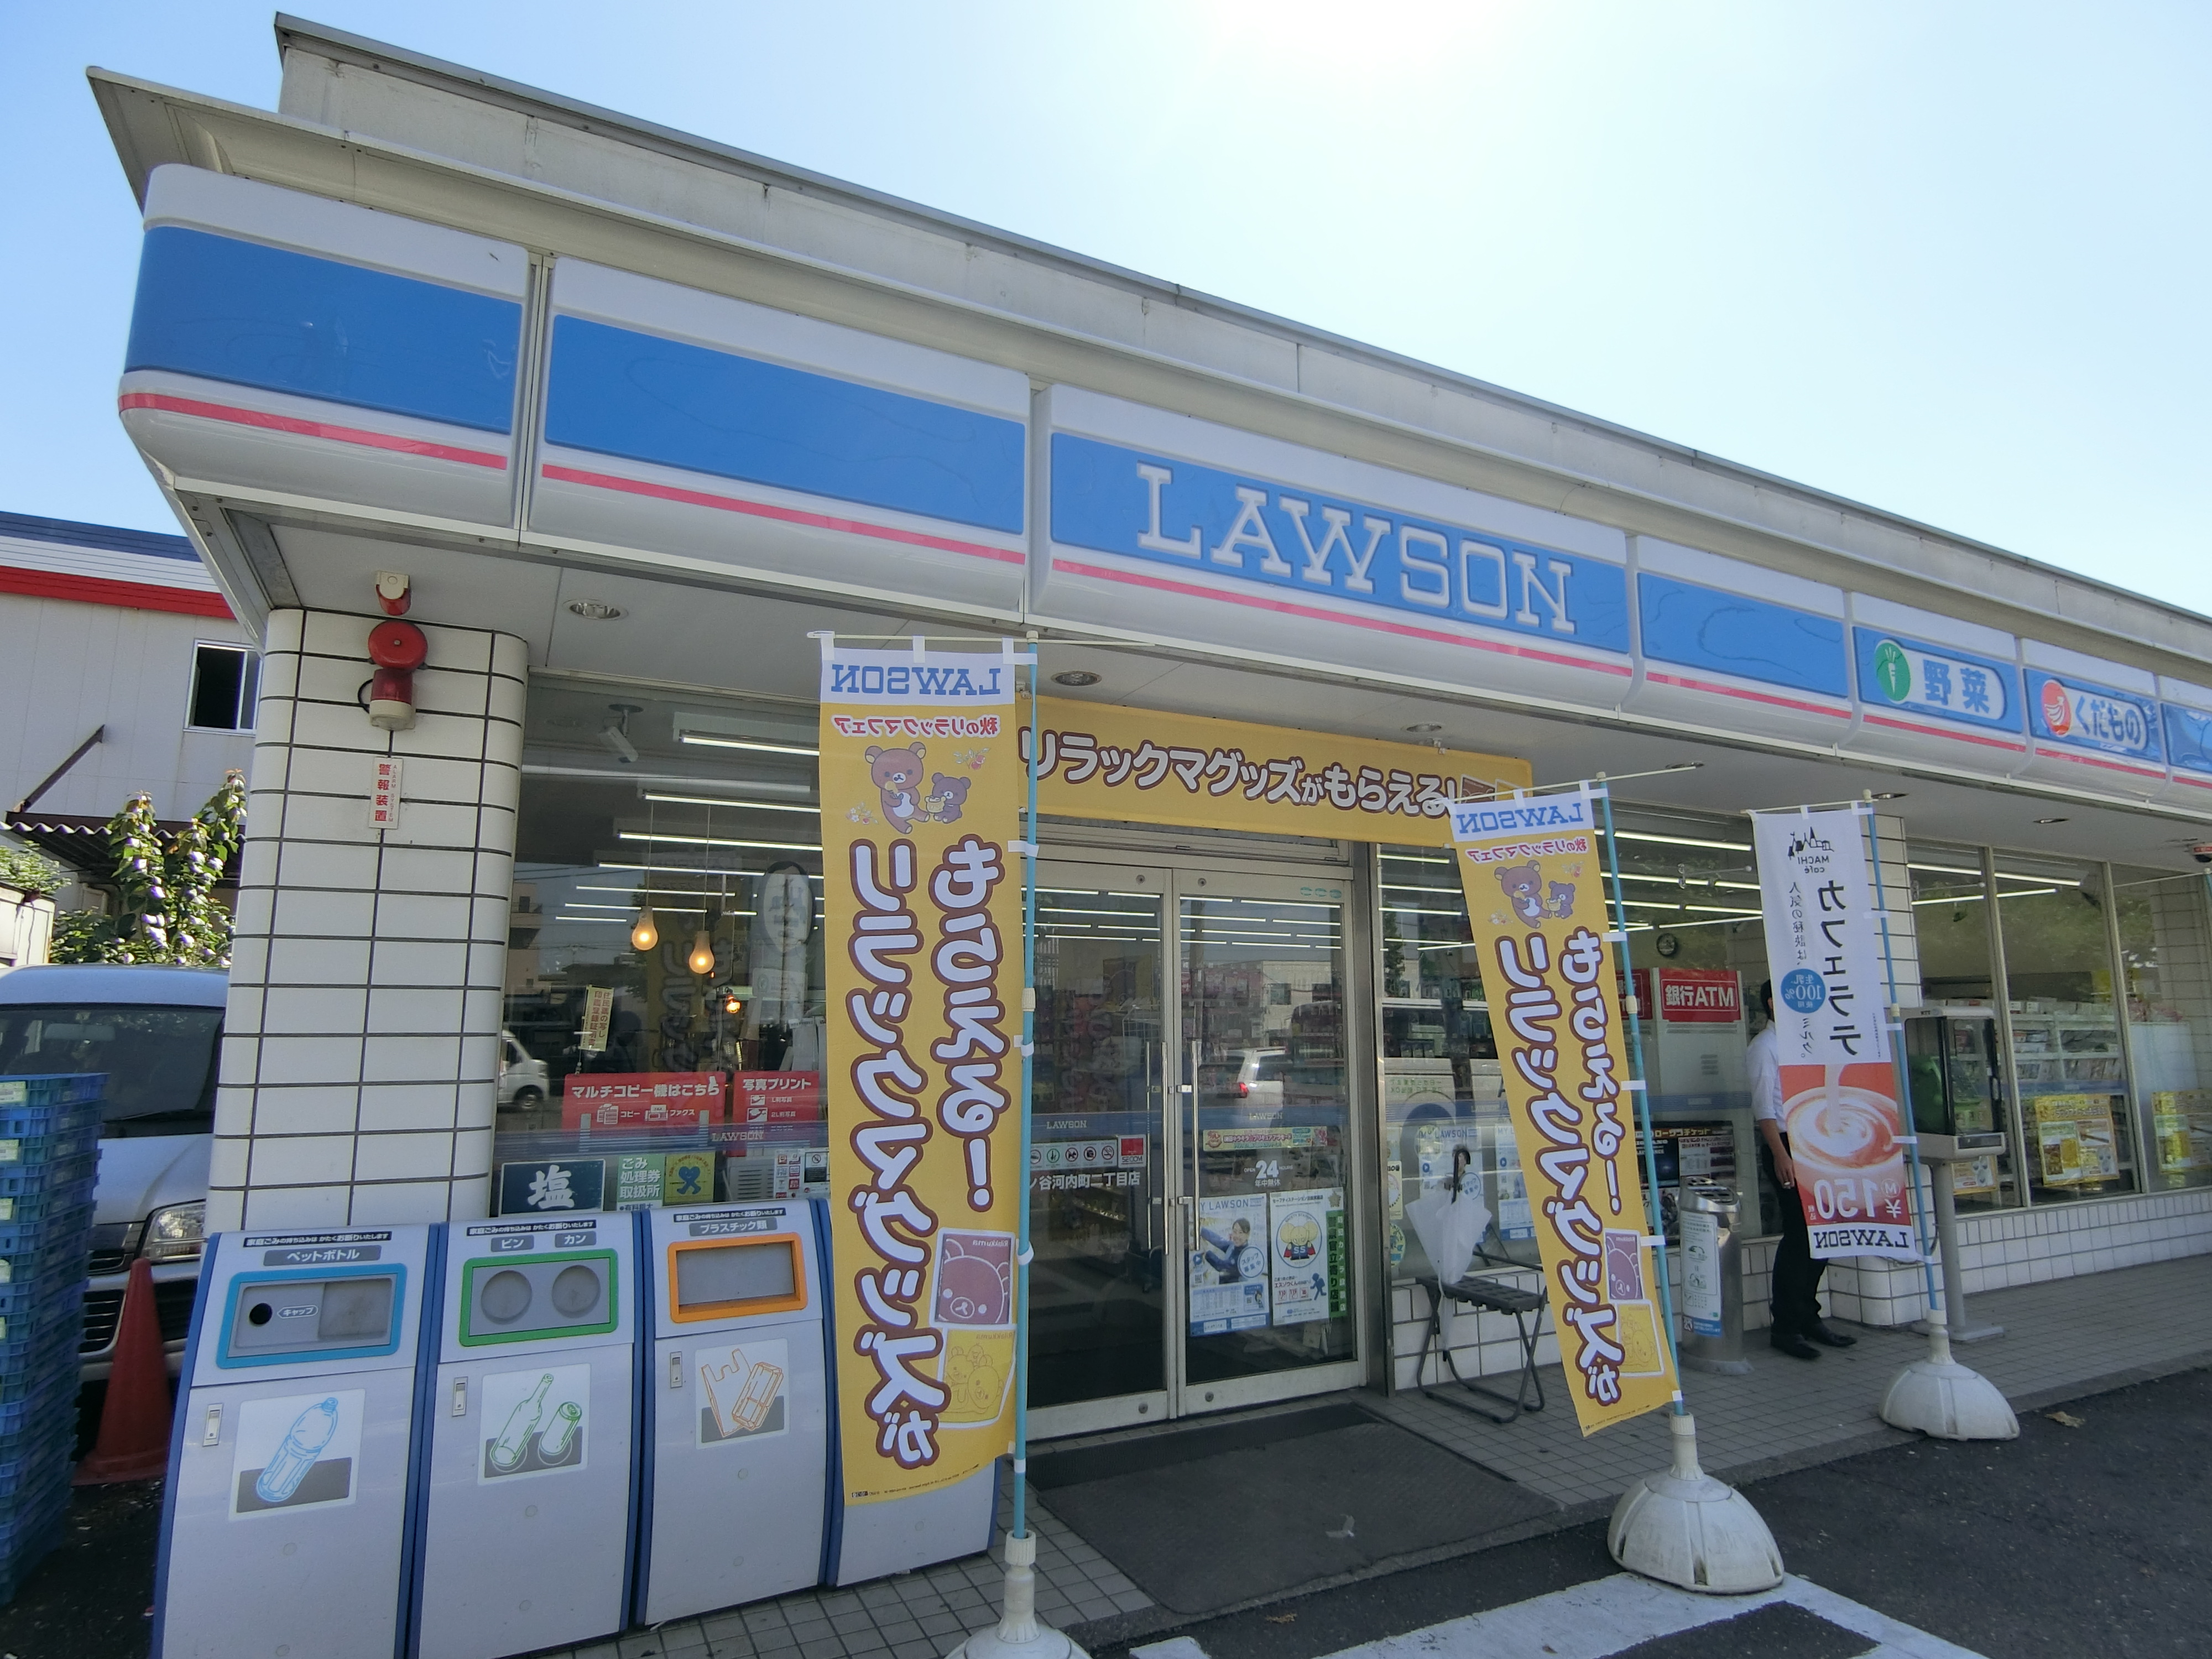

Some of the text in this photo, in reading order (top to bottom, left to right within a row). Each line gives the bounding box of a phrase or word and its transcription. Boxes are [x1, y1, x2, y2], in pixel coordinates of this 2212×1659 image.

[1136, 460, 1575, 635] LAWSON
[1922, 659, 1990, 714] 野菜
[2074, 695, 2140, 745] くだもの
[375, 764, 392, 822] 警報装置
[1665, 984, 1734, 1007] 銀行ATM
[571, 1083, 720, 1099] マルチコピー機はこちら
[743, 1078, 812, 1091] 写真プリント
[620, 1109, 640, 1118] コピー
[670, 1109, 695, 1117] ファクス
[1249, 1112, 1283, 1120] LAWSON
[1046, 1120, 1087, 1129] LAWSON
[711, 1131, 764, 1142] LAWSON
[1435, 1129, 1468, 1139] LAWSON
[622, 1157, 649, 1170] ごみ
[1255, 1160, 1279, 1178] 24
[620, 1171, 661, 1185] 処理券
[1254, 1178, 1281, 1187] 年中無休
[527, 1164, 575, 1209] 塩
[619, 1185, 660, 1199] 取扱所
[1209, 1198, 1249, 1211] LAWSON
[700, 1220, 768, 1234] プラスチック類
[501, 1238, 525, 1249] ビン
[564, 1233, 588, 1245] カン
[286, 1249, 361, 1262] ペットボトル
[1293, 1245, 1307, 1254] SS
[283, 1307, 314, 1317] キャップ
